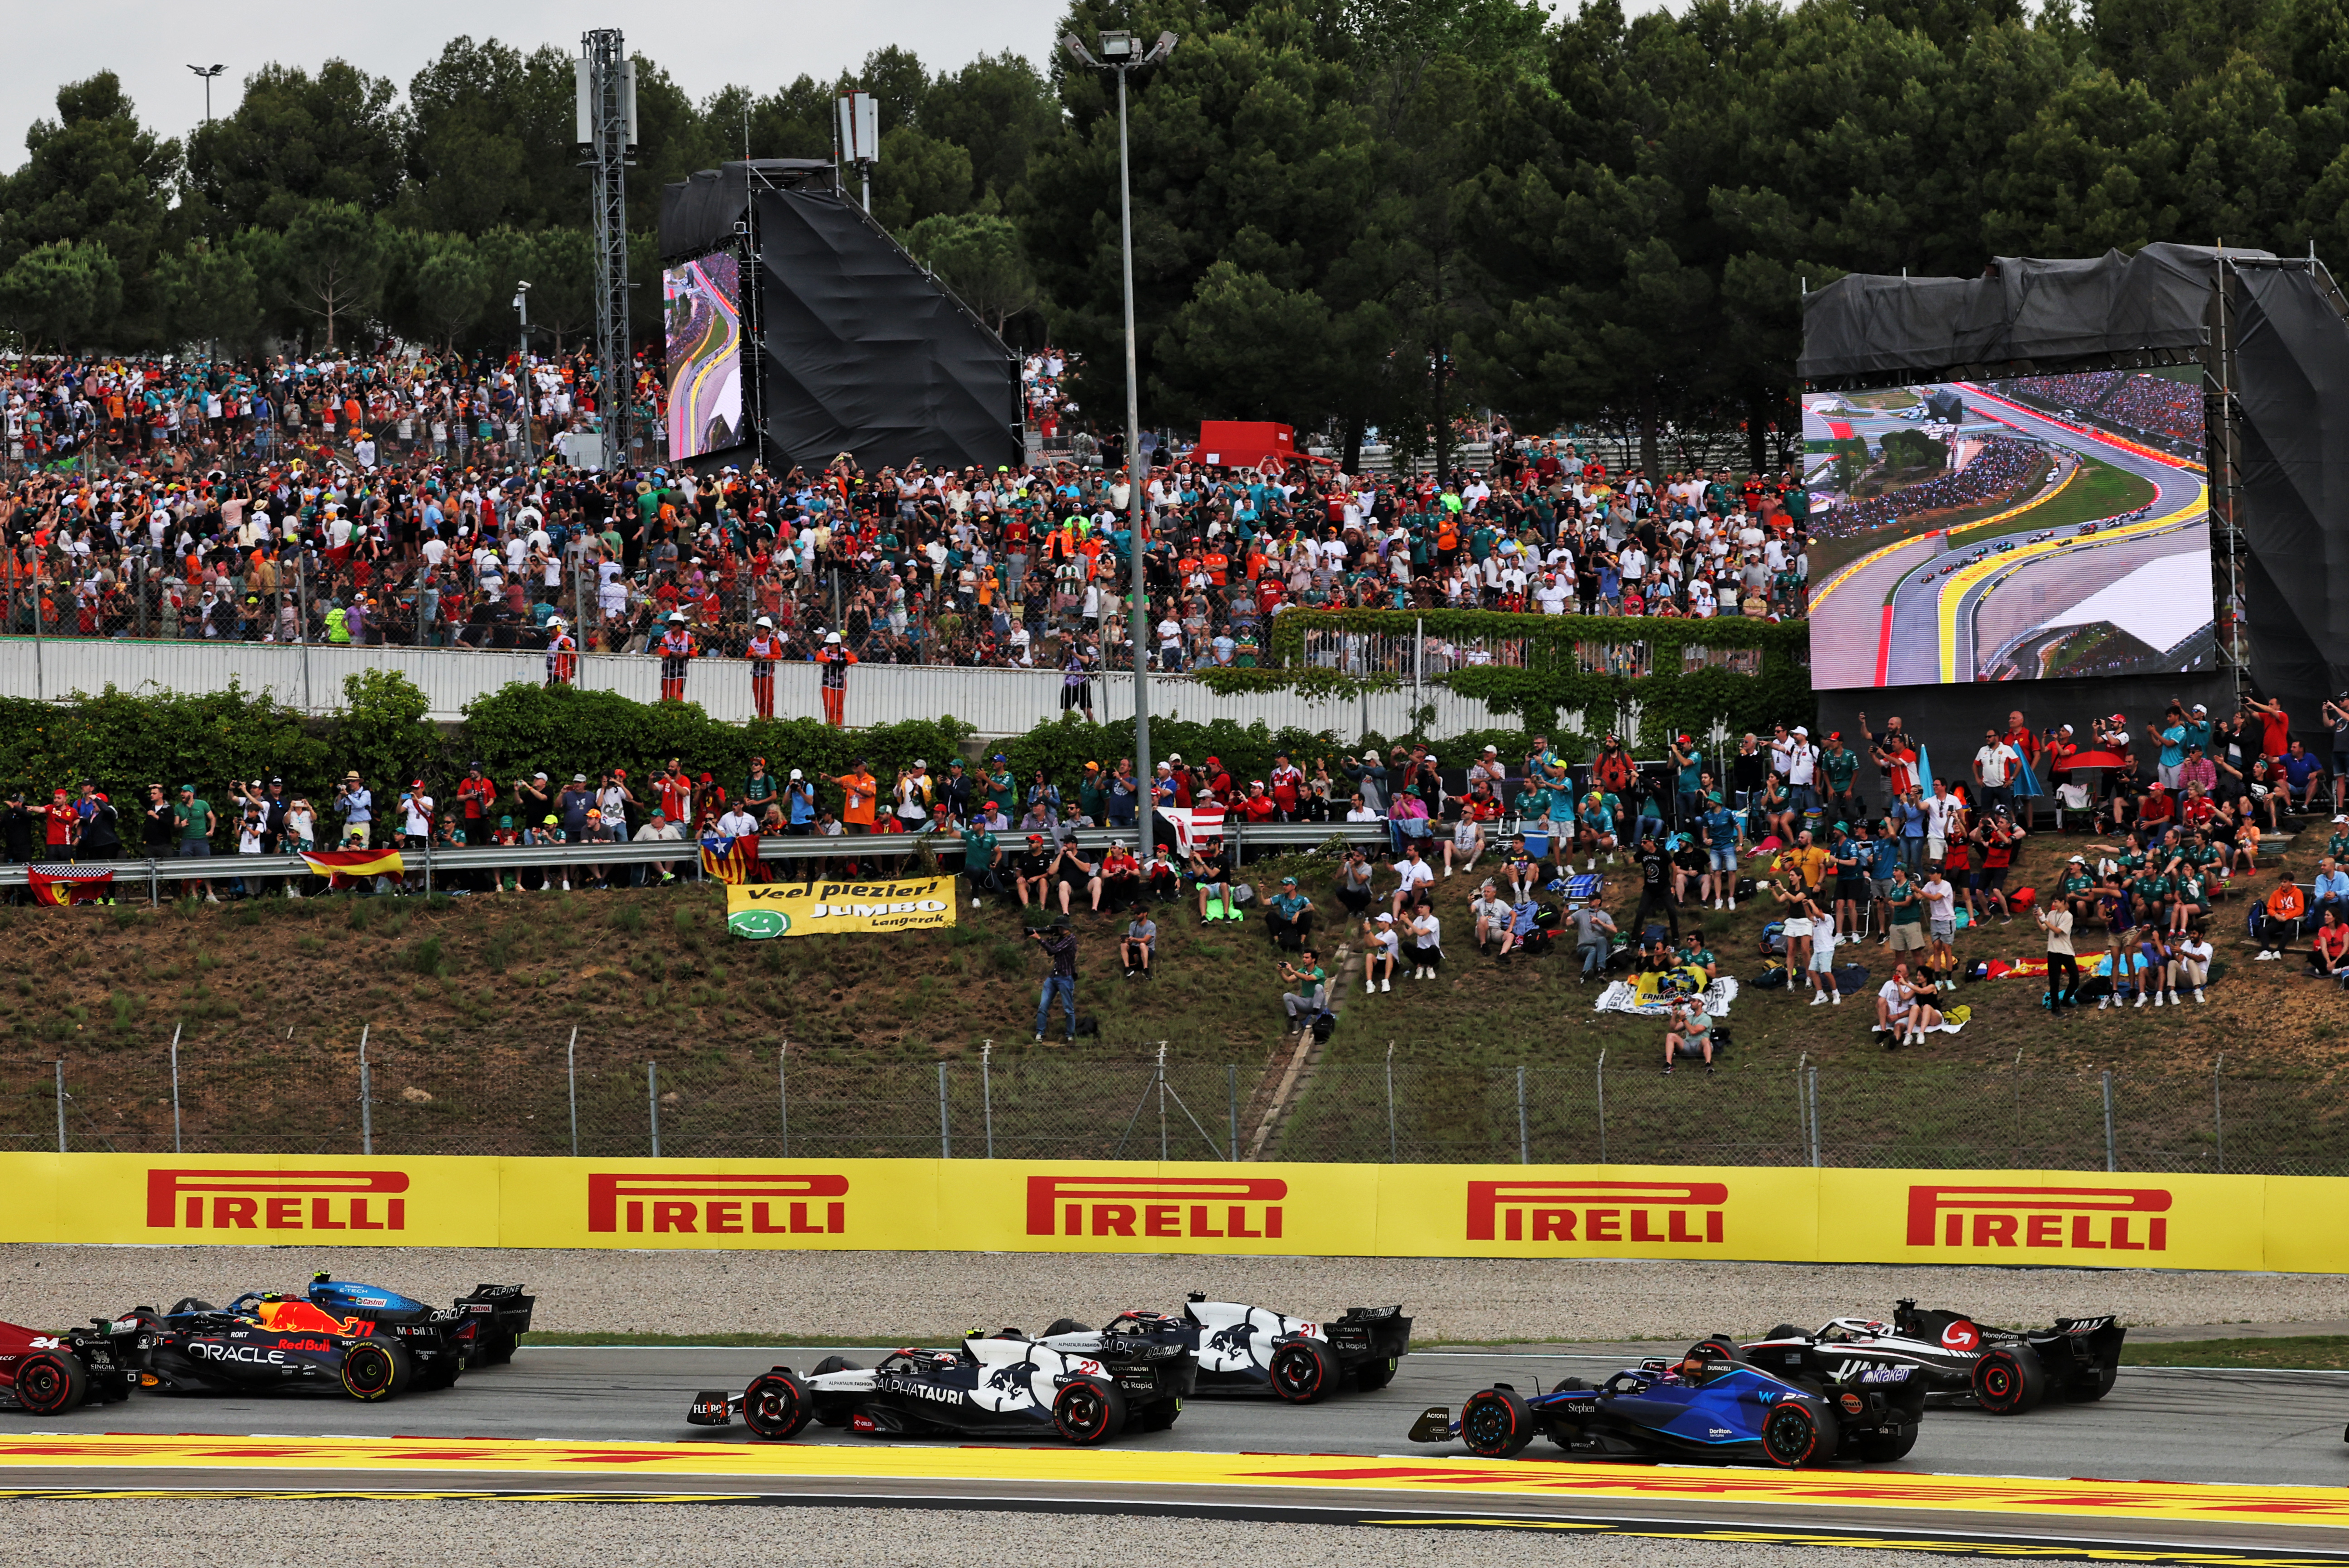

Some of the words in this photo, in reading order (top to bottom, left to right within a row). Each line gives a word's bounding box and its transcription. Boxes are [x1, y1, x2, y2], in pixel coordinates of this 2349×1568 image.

[748, 882, 813, 900] Veel
[871, 914, 943, 927] Langerak
[1641, 992, 1679, 1000] ERNANDO
[146, 1169, 410, 1230] PIRELLI
[588, 1173, 849, 1234] PIRELLI
[1026, 1176, 1288, 1239] PIRELLI
[1466, 1181, 1729, 1243] PIRELLI
[1906, 1185, 2173, 1250] PIRELLI
[489, 1285, 521, 1296] ALPINE
[354, 1320, 376, 1337] 11
[396, 1326, 426, 1336] Mobil
[1298, 1323, 1316, 1337] 21
[1982, 1331, 2019, 1340] MoneyGram
[29, 1336, 60, 1349] 24
[278, 1338, 304, 1351] Red
[304, 1339, 330, 1352] Bull
[188, 1343, 285, 1365] ORACLE
[1078, 1361, 1100, 1375] 22
[1873, 1368, 1909, 1383] kraken
[877, 1378, 964, 1405] ALPHATAURI
[1131, 1381, 1153, 1390] Rapid
[693, 1401, 727, 1418] FLEXBOX
[1568, 1403, 1595, 1414] Stephen
[1841, 1399, 1862, 1407] Gulf
[1879, 1426, 1889, 1434] sia
